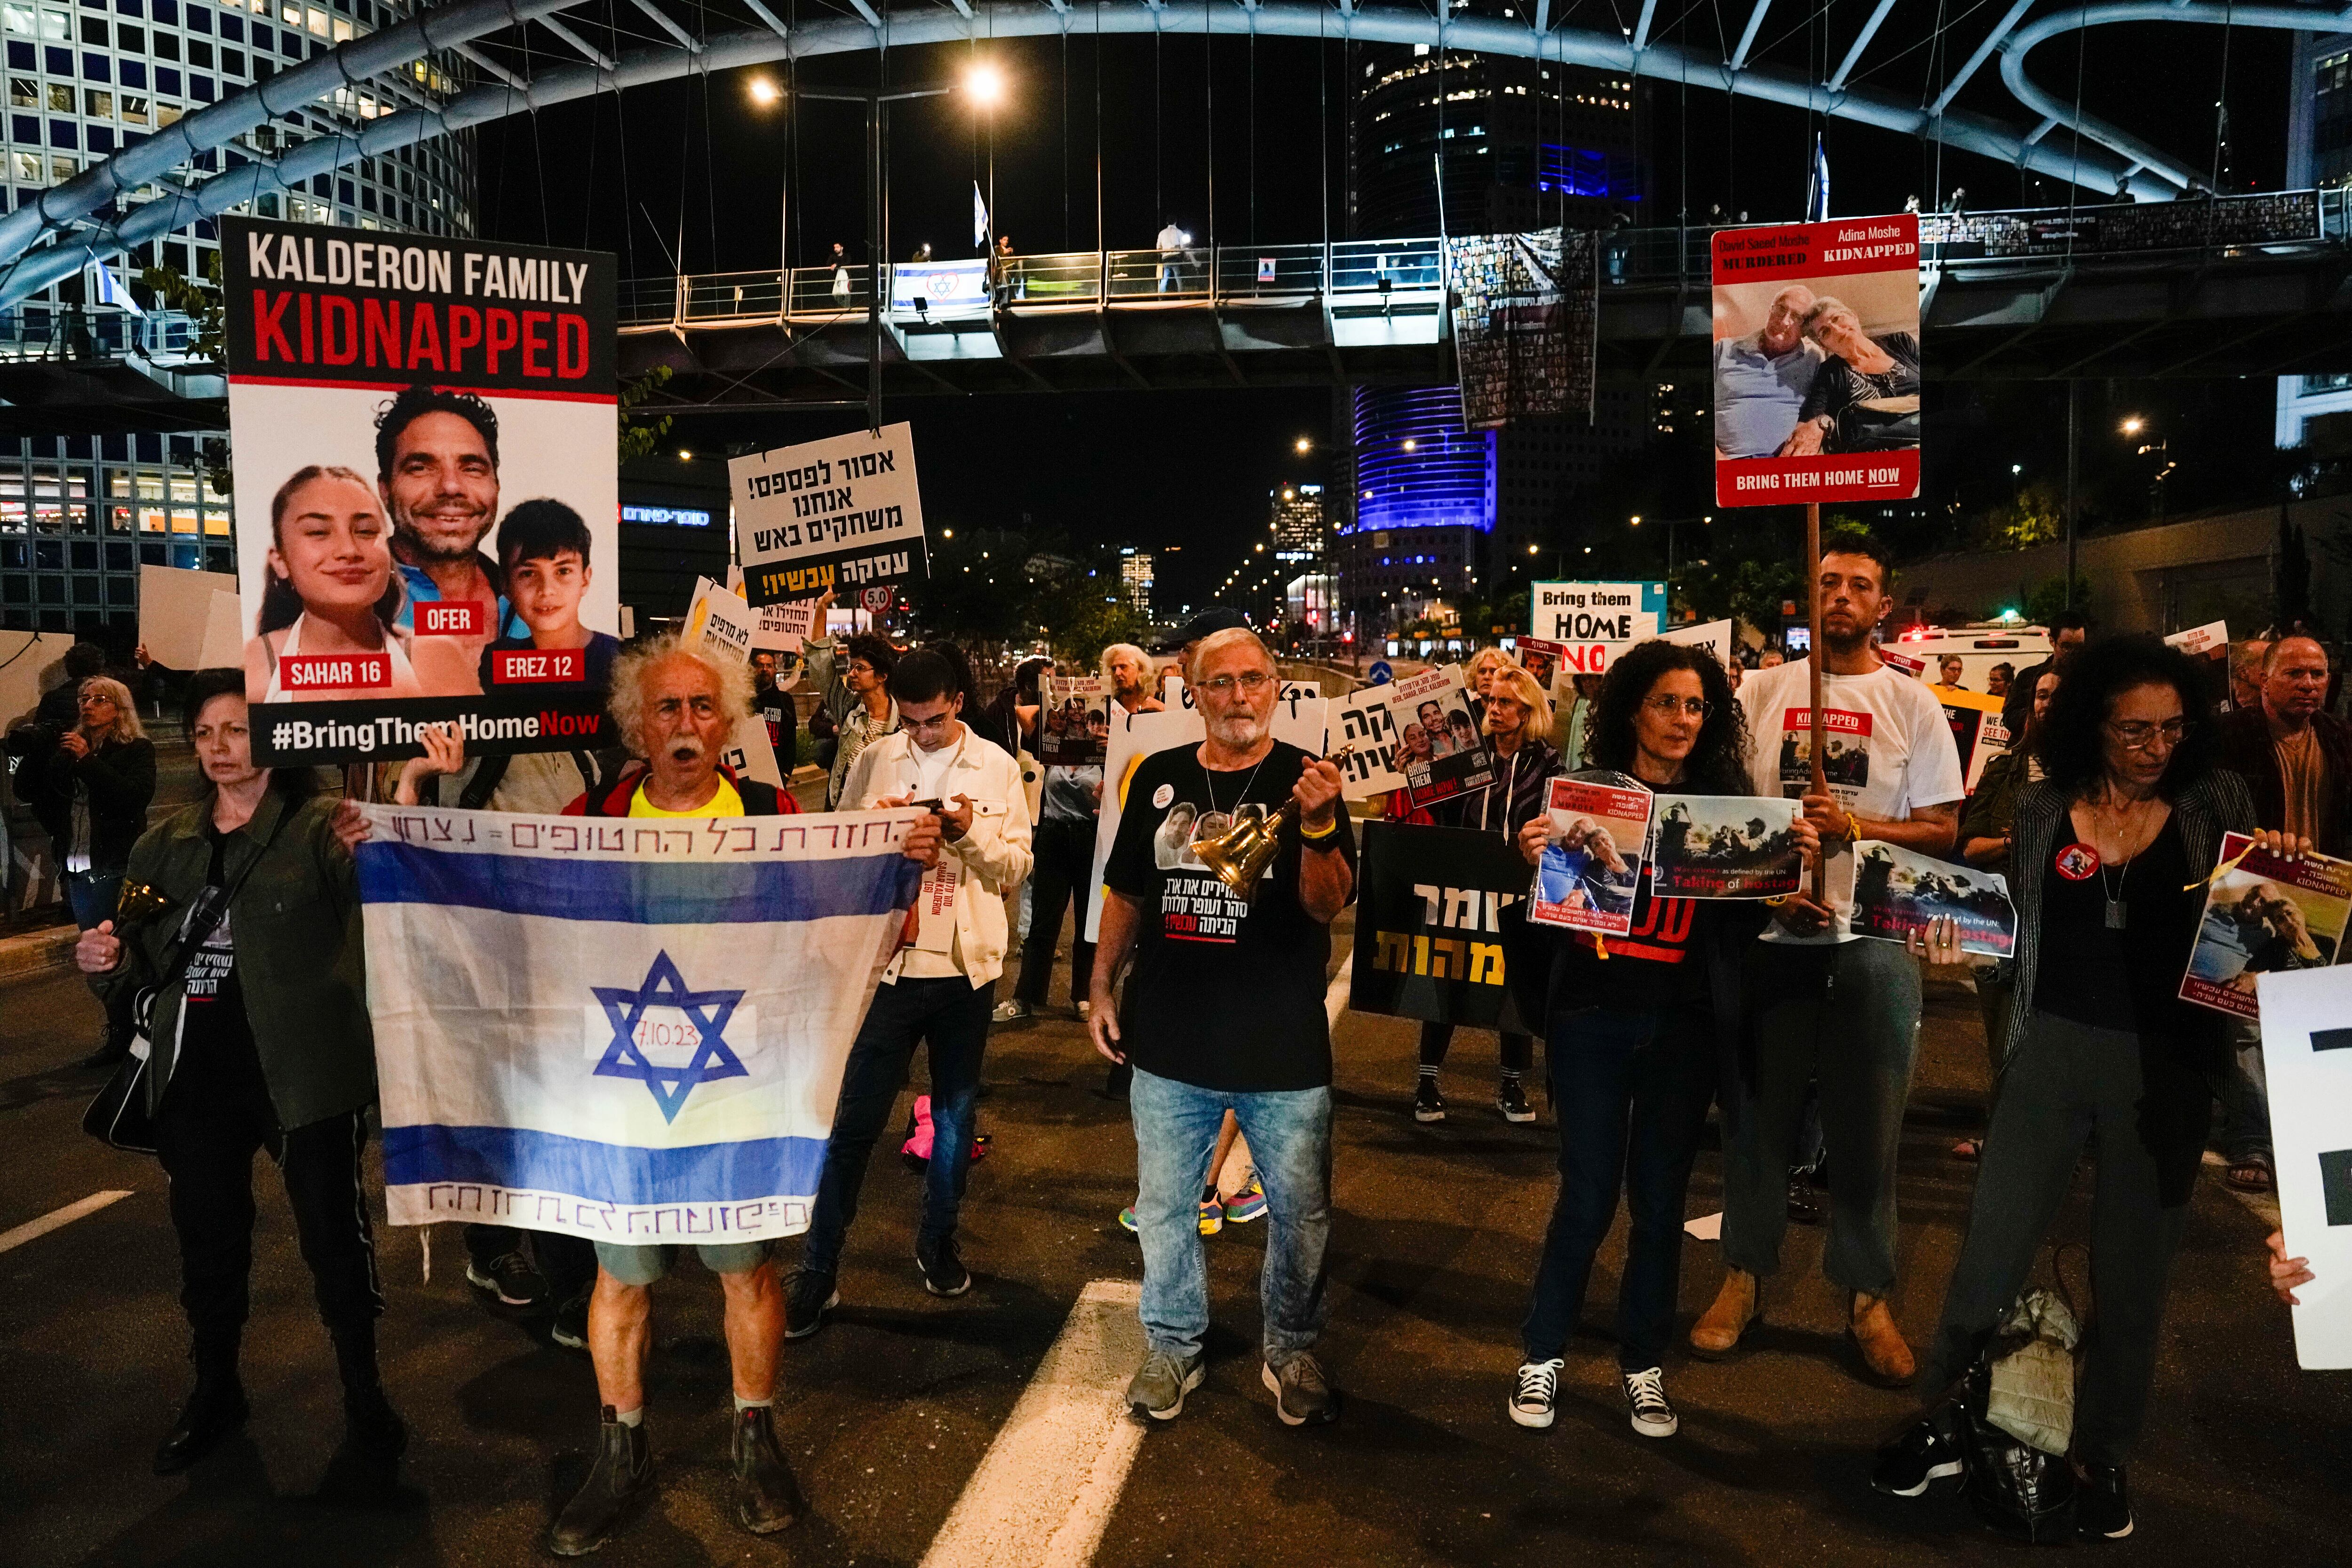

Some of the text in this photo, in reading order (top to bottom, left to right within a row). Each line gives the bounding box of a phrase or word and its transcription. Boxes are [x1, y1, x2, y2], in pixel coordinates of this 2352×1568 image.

[1838, 225, 1901, 243] Adina Moshe
[1723, 252, 1807, 271] MURDERED
[1823, 242, 1916, 262] KIDNAPPED
[248, 231, 588, 304] KALDERON FAMILY
[254, 289, 589, 378] KIDNAPPED
[748, 450, 896, 500] אסור לפספס!
[1736, 468, 1899, 491] BRING THEM HOME NOW
[793, 486, 854, 517] אנחנו
[754, 505, 903, 552] משחקים באש
[763, 551, 909, 596] עסקה עכשיו!
[1543, 591, 1631, 608] Bring them
[427, 609, 471, 629] OFER
[777, 607, 809, 621] תחזירו
[710, 613, 749, 645] לא מרפים
[759, 619, 806, 635] החטופים!
[1556, 613, 1631, 639] HOME
[1532, 640, 1549, 650] חטוף
[506, 656, 572, 677] EREZ 12
[1893, 655, 1911, 666] חטוף
[291, 661, 381, 685] SAHAR 16
[1392, 677, 1451, 704] OFER, SAHAR, EREZ, KALDERON
[1796, 712, 1859, 728] KIAPPED
[1986, 716, 1999, 726] WE
[1042, 734, 1060, 745] BRING
[1983, 727, 1999, 738] SEE
[1042, 743, 1058, 753] THEM
[1407, 760, 1430, 777] BRING
[1410, 772, 1432, 788] THEM
[1413, 777, 1458, 800] HOME NOW!
[1607, 808, 1645, 819] KIDNAPPED
[512, 822, 693, 855] החטופים
[707, 817, 756, 854] כל
[923, 881, 935, 893] (16)
[931, 861, 947, 915] SAHAR KALDERON
[1183, 878, 1200, 895] את
[1673, 875, 1725, 891] Taking
[1728, 878, 1740, 889] of
[2296, 876, 2347, 896] KIDNAPPED
[943, 895, 954, 907] סהר
[1162, 895, 1248, 918] סהר ועופר קלדרון
[1165, 914, 1237, 935] הביתה עכשיו!
[1963, 916, 1972, 925] by
[638, 1020, 699, 1047] 7.10.23
